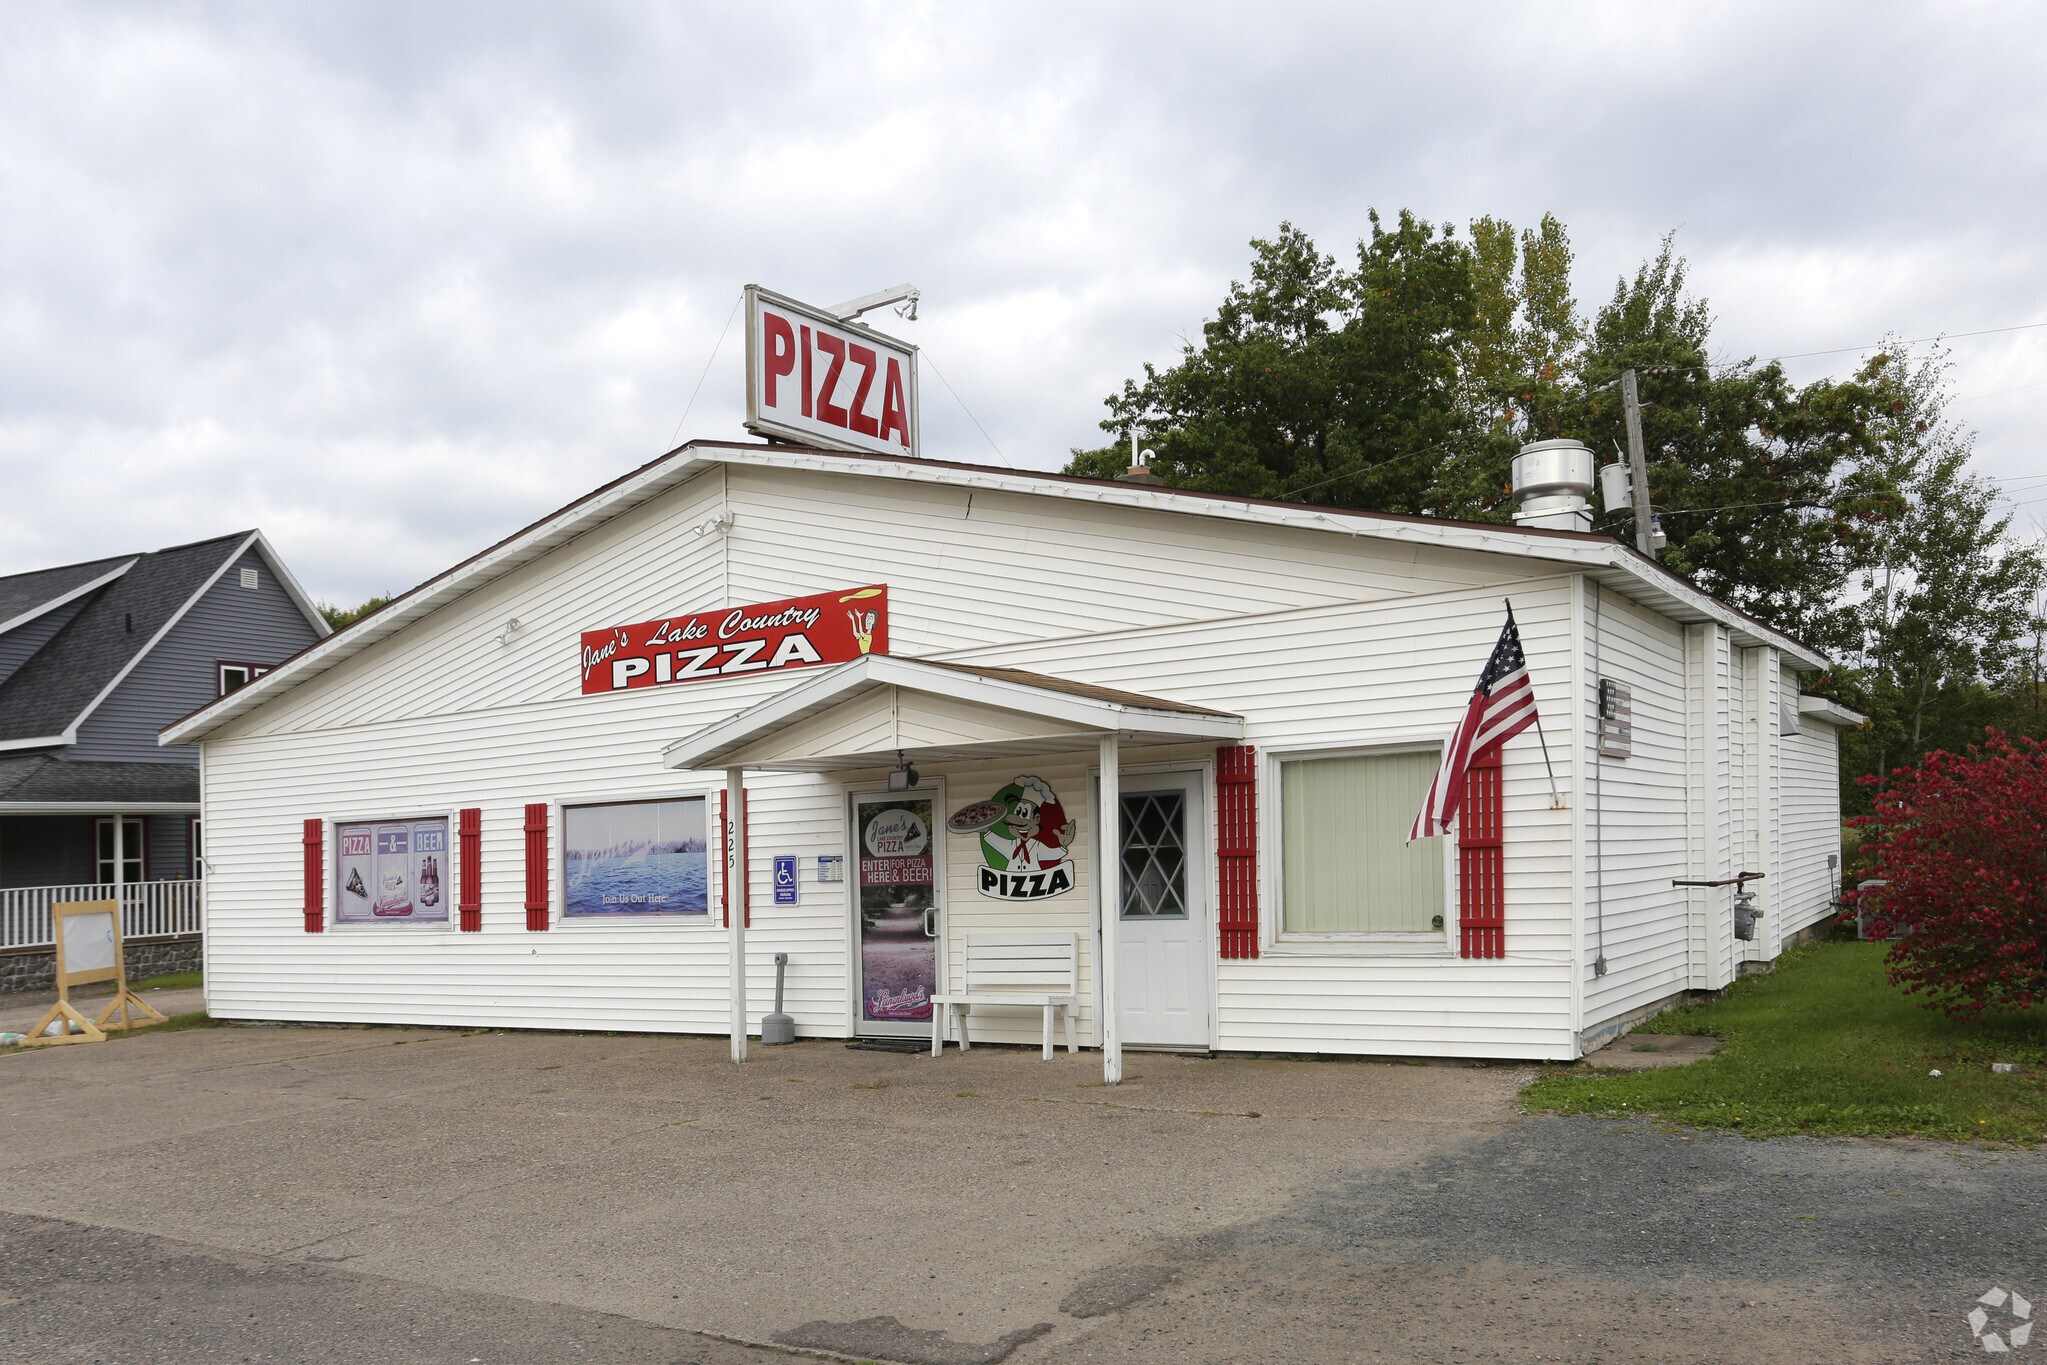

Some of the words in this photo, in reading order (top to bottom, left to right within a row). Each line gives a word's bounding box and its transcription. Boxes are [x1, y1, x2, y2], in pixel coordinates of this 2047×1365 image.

[764, 312, 910, 448] PIZZA
[582, 629, 629, 680] Jane's
[645, 618, 708, 647] Lake
[718, 606, 821, 640] Country
[612, 633, 822, 689] PIZZA
[871, 815, 907, 842] Jane's
[343, 836, 371, 855] PIZZA
[416, 832, 443, 852] BEER
[877, 840, 904, 853] PIZZA
[862, 859, 890, 871] ENTER
[891, 859, 905, 868] FOR
[907, 858, 926, 867] PIZZA
[868, 871, 890, 883] HERE
[892, 869, 899, 882] &
[902, 868, 932, 881] BEER!
[981, 868, 1070, 897] PIZZA
[602, 894, 617, 905] Join
[619, 894, 629, 903] Us
[631, 893, 646, 903] Out
[648, 893, 666, 903] Here
